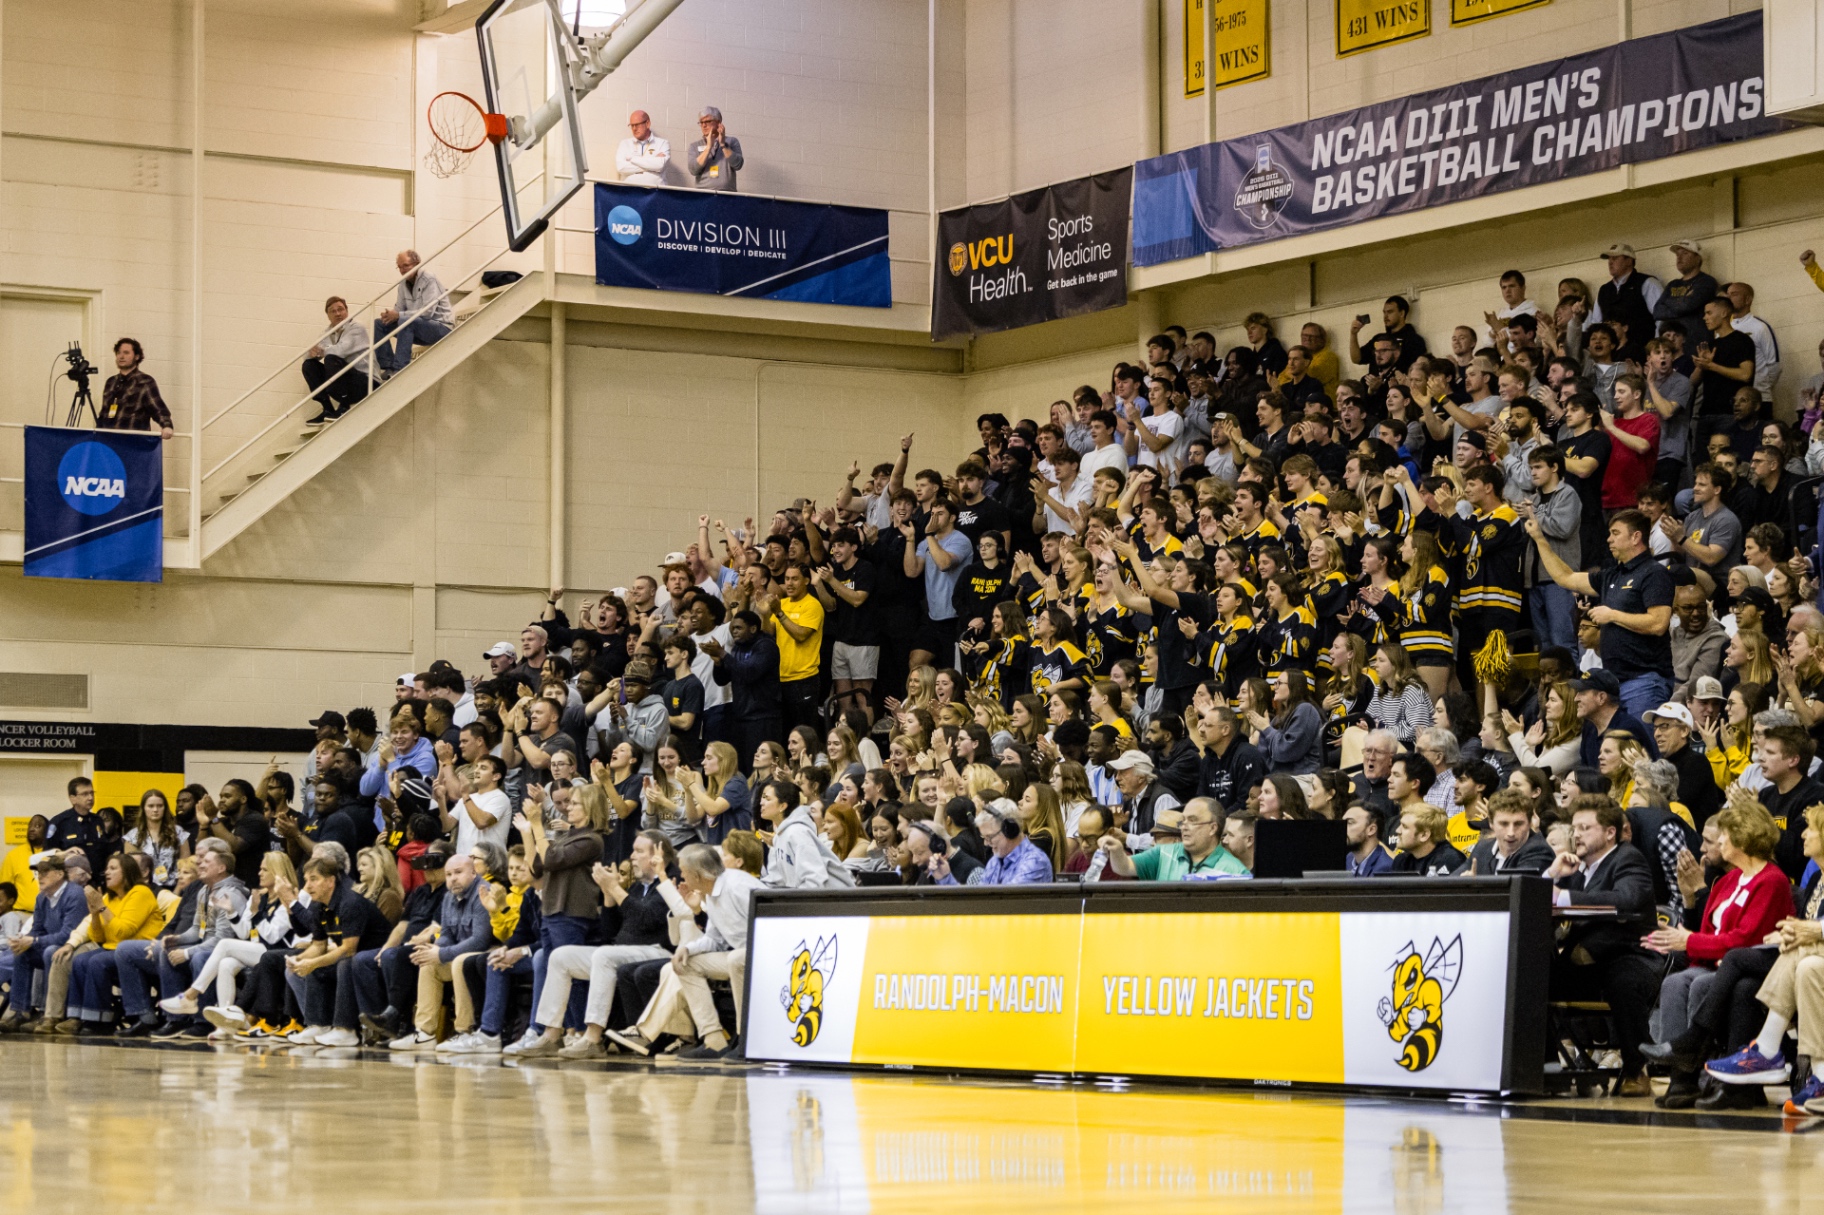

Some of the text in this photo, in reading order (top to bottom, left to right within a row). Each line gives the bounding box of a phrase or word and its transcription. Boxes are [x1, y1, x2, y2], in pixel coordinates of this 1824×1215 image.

[1214, 10, 1247, 33] 56-1975
[1346, 2, 1419, 38] 431 WINS
[1219, 44, 1259, 71] WINS
[1311, 67, 1601, 170] NCAA DIII MEN'S
[1311, 134, 1520, 214] BASKETBALL
[1236, 183, 1292, 206] CHAMPIONSHIP
[611, 223, 642, 236] NCAA
[657, 218, 787, 250] DIVISION III
[1047, 214, 1093, 244] Sports
[657, 241, 787, 260] DISCOVER DEVELOP DEDICATE
[968, 233, 1014, 271] VCU
[1047, 240, 1112, 271] Medicine
[970, 265, 1027, 303] Health
[1047, 268, 1118, 291] Get back in the game
[64, 475, 126, 498] NCAA
[971, 577, 1002, 586] RANOLPH
[28, 725, 96, 736] VOLLEYBALL
[43, 738, 76, 749] ROOM
[874, 973, 1064, 1014] RANDOLPH-MACON
[1102, 976, 1315, 1021] YELLOW JACKETS
